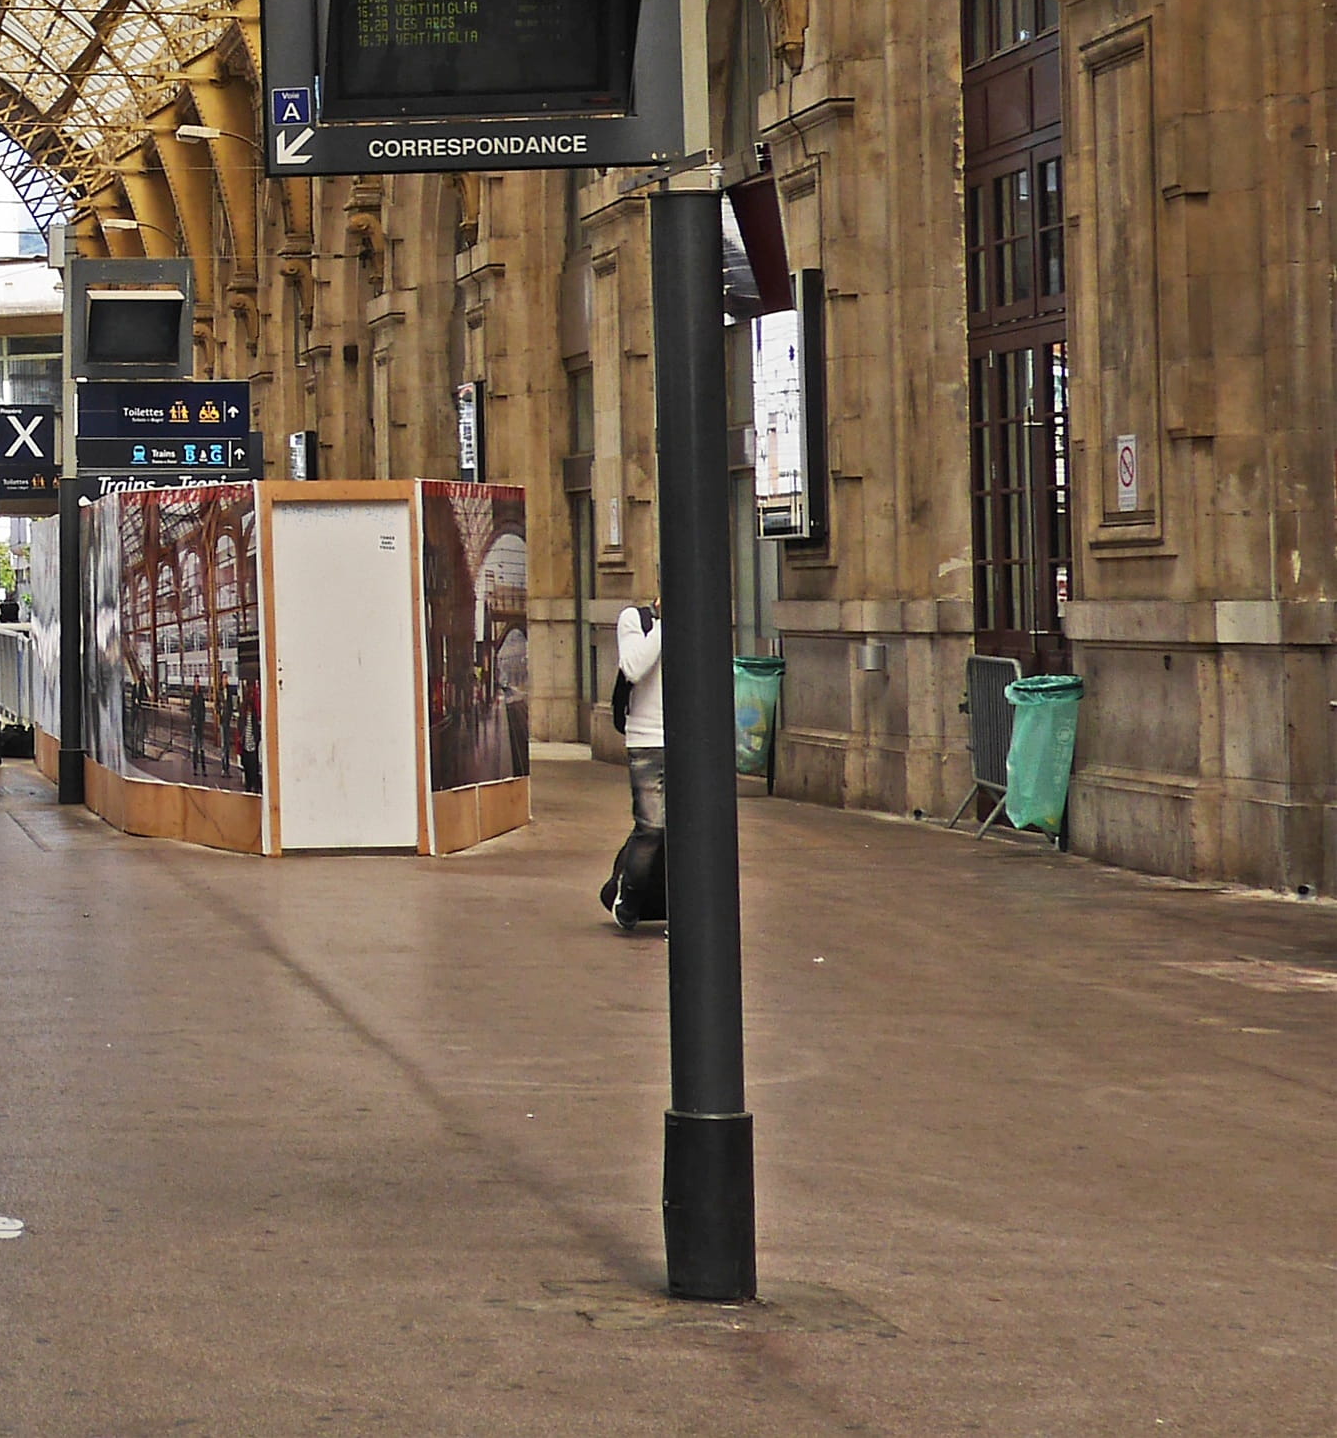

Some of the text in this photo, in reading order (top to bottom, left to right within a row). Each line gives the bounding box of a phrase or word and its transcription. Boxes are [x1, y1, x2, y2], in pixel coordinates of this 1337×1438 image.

[395, 2, 478, 16] VENTIMIGLIA
[396, 18, 417, 31] LES
[426, 16, 455, 30] ARCS
[396, 31, 478, 46] VENTIMIGLIA
[281, 91, 300, 100] Voie
[282, 102, 301, 121] A
[368, 135, 588, 158] CORRESPONDANCE
[123, 408, 164, 417] Toilettes
[5, 416, 44, 457] X
[151, 449, 176, 458] Trains
[211, 450, 222, 462] G
